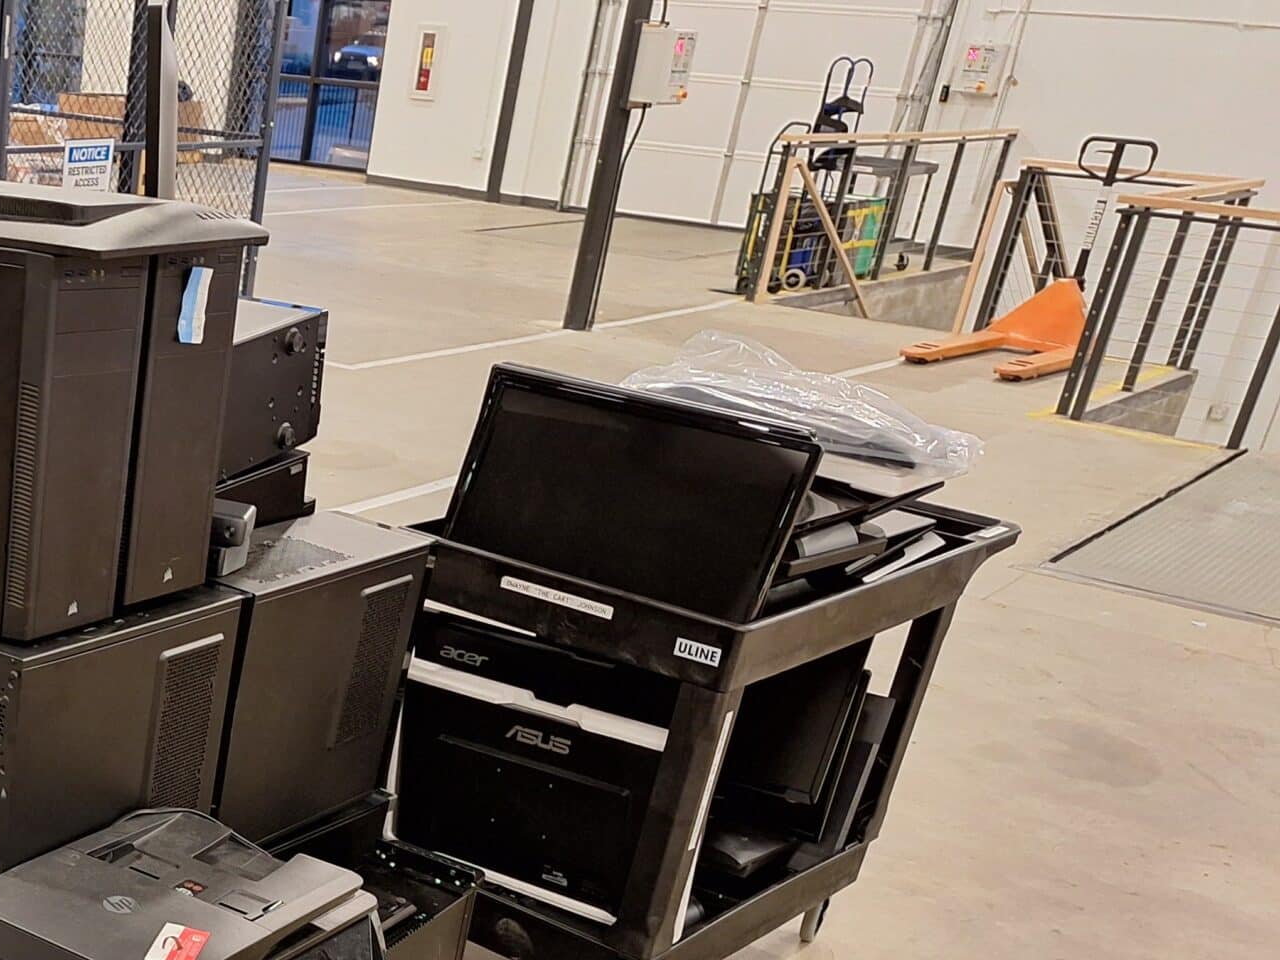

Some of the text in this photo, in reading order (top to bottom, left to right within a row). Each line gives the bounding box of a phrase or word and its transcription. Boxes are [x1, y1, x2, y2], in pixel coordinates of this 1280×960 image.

[72, 147, 108, 161] NOTICE
[68, 166, 106, 176] RESTRICTED
[74, 177, 99, 187] ACCESS
[440, 645, 489, 667] acer
[678, 641, 718, 663] ULINE
[505, 725, 572, 754] ASUS
